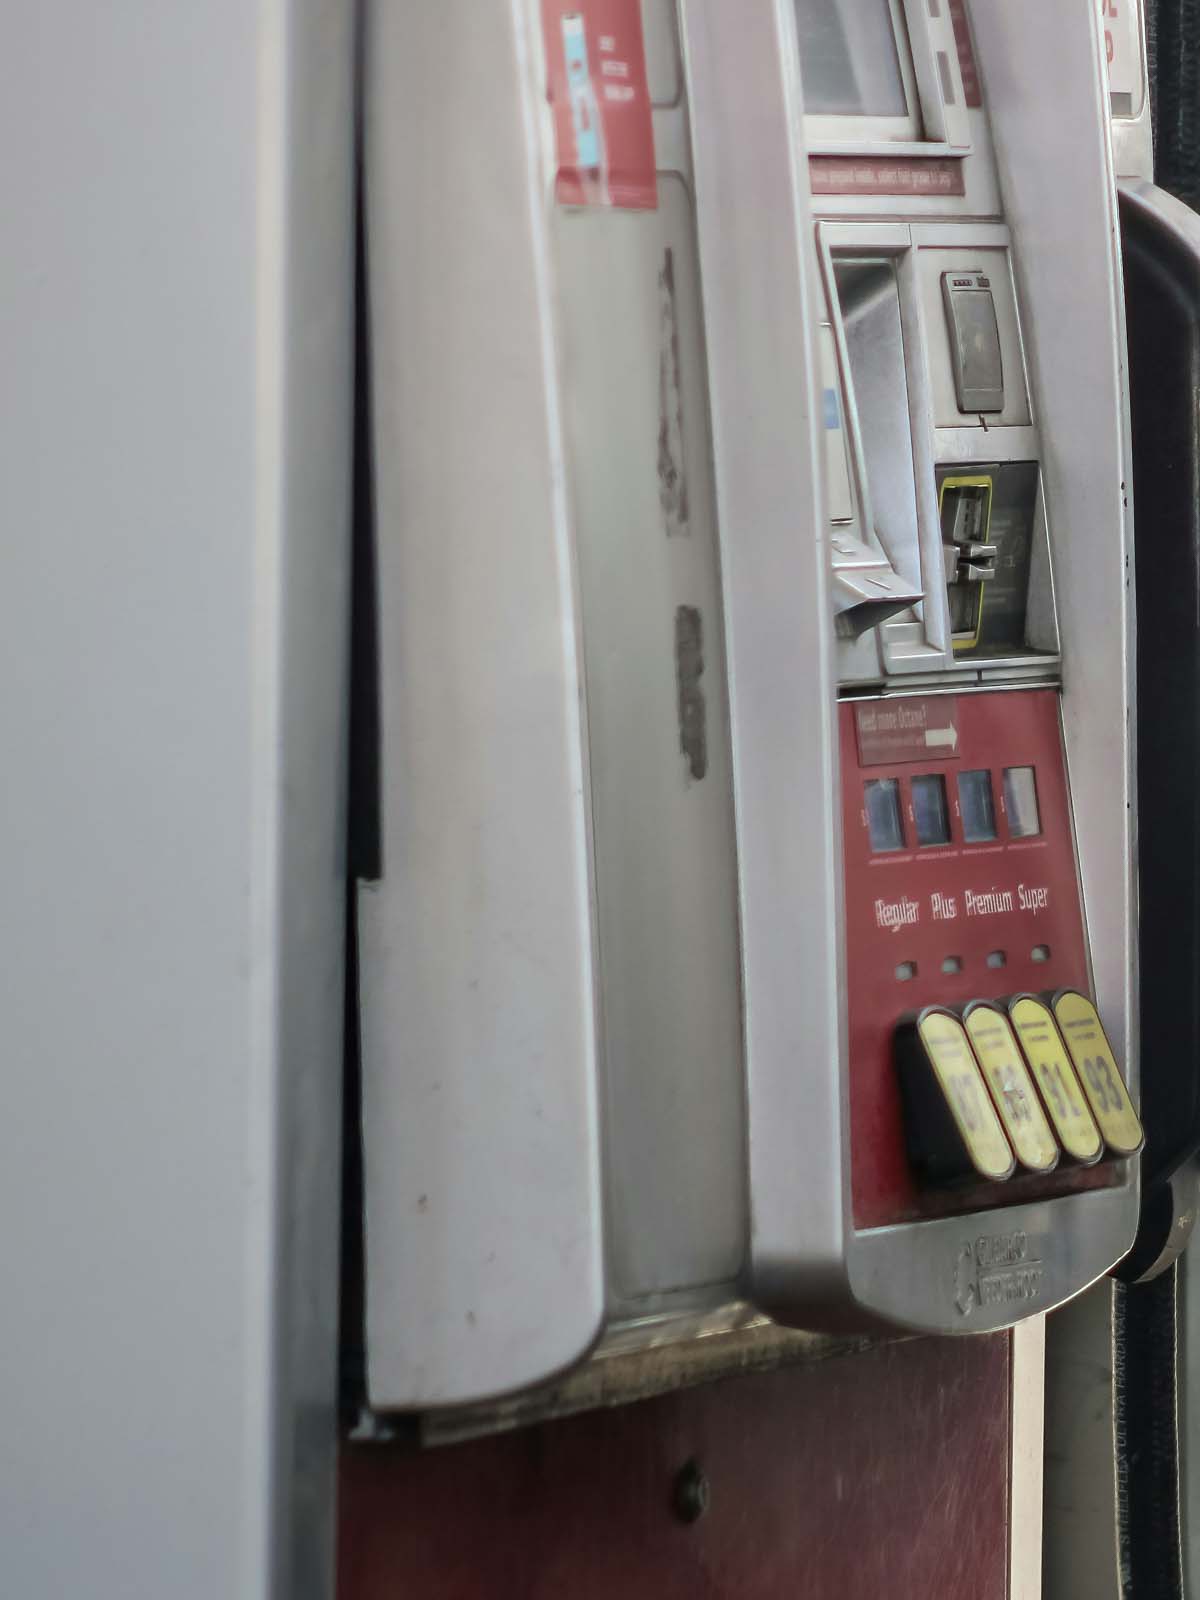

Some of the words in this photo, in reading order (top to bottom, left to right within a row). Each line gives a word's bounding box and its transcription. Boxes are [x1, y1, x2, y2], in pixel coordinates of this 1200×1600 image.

[875, 896, 920, 933] Regular
[930, 892, 957, 921] Plus
[964, 886, 1014, 917] Premium
[1017, 882, 1049, 915] Super
[1083, 1055, 1123, 1114] 93
[1115, 1395, 1128, 1447] ULTRA
